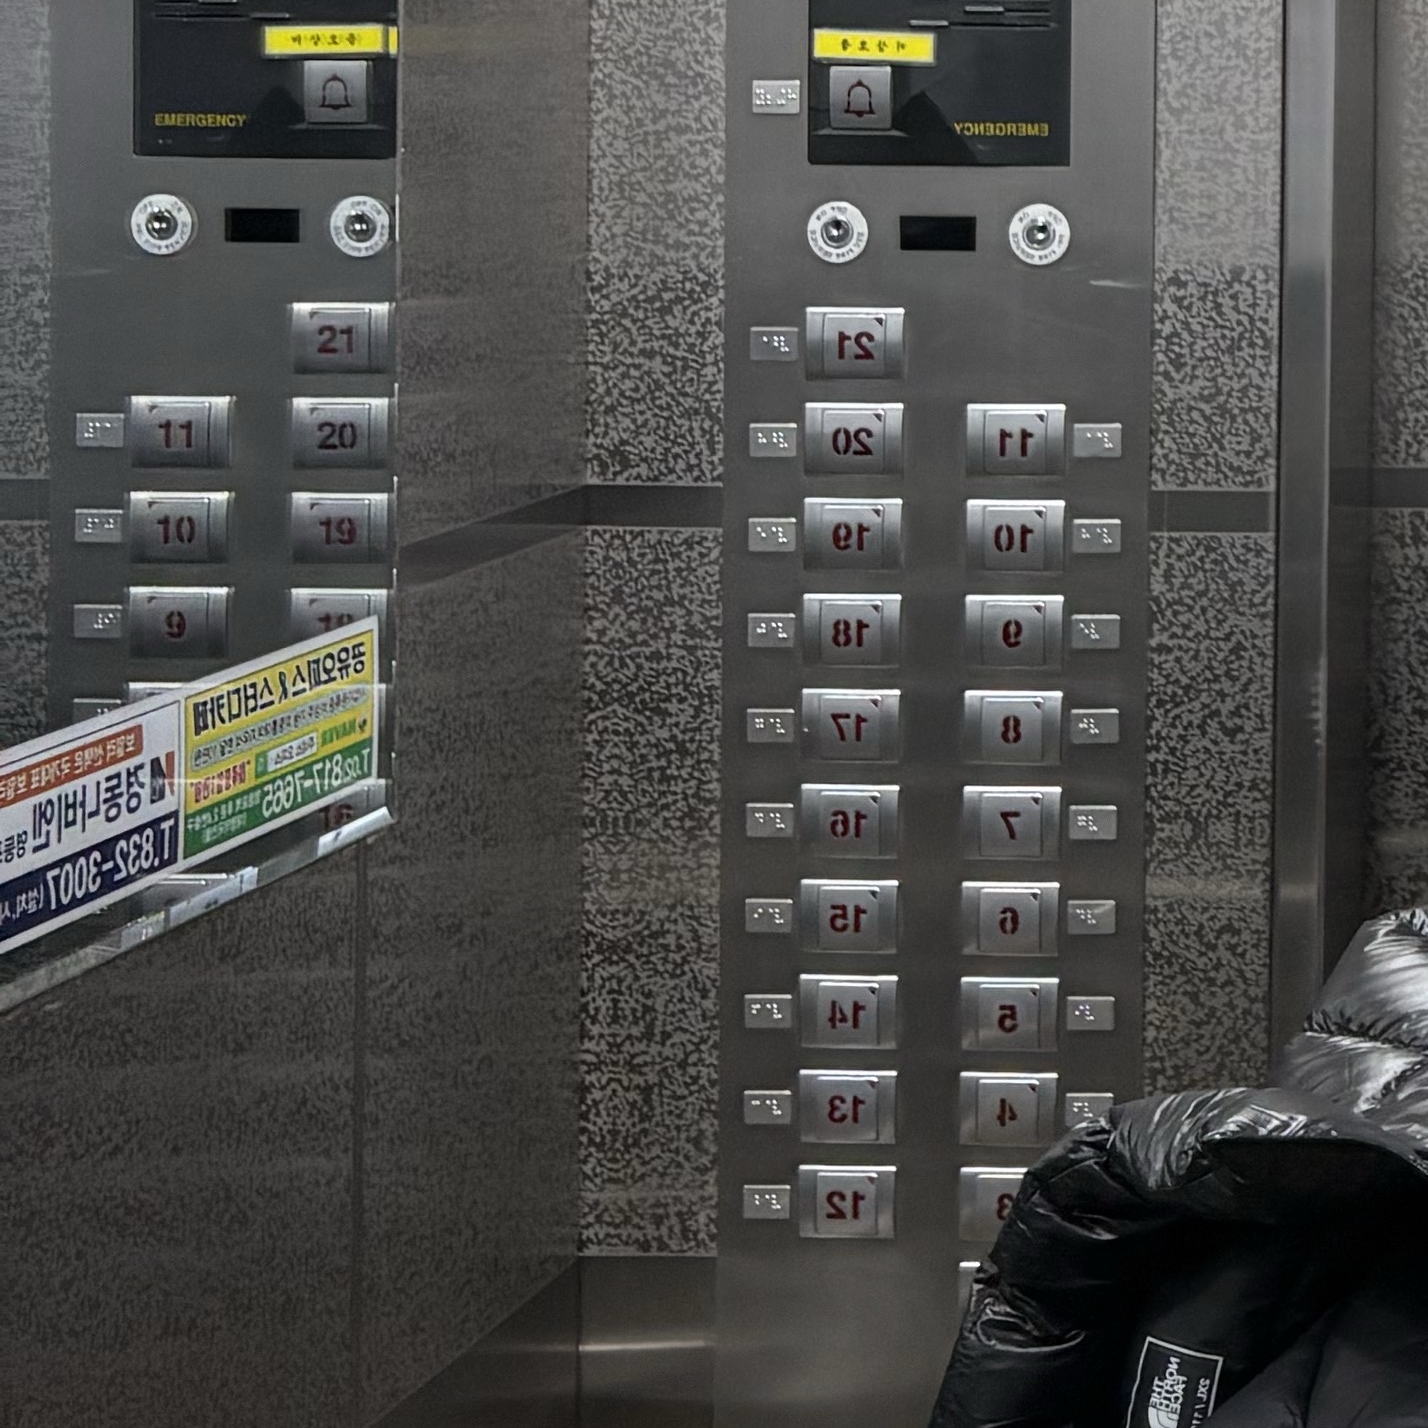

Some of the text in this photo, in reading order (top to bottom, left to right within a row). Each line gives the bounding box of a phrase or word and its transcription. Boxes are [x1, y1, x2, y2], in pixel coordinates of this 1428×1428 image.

[155, 113, 246, 128] EMERGENCY
[317, 325, 355, 355] 21
[158, 419, 195, 449] 11
[317, 421, 357, 450] 20
[157, 515, 195, 545] 10
[318, 517, 357, 546] 19
[165, 610, 185, 640] 9
